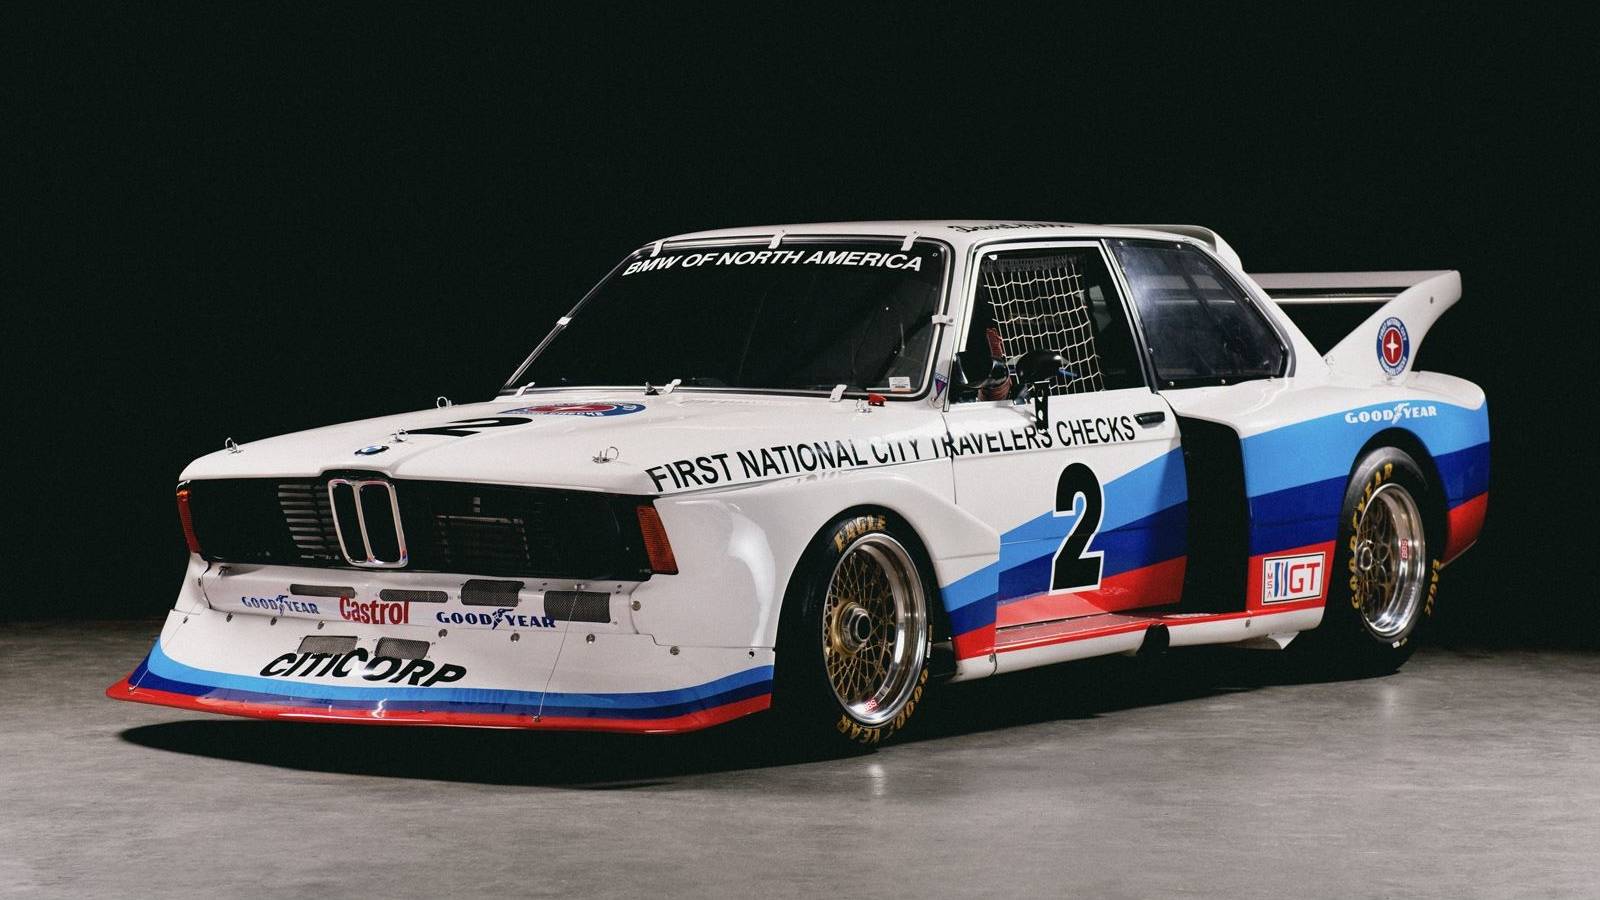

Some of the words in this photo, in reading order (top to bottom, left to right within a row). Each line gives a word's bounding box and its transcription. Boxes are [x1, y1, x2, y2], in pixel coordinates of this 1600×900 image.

[622, 255, 683, 276] BMW
[681, 253, 719, 268] OF
[716, 250, 805, 266] NORTH
[803, 250, 922, 272] AMERICA
[1344, 403, 1438, 425] GOODYEAR
[645, 453, 733, 493] FIRST
[736, 439, 868, 479] NATIONAL
[1056, 415, 1136, 447] CHECKS
[834, 515, 888, 552] EAGLE
[1050, 462, 1104, 593] 2
[1289, 562, 1321, 593] GT
[241, 594, 321, 616] GOODYEAR
[339, 592, 409, 625] Castrol
[436, 608, 557, 630] GOODYEAR
[259, 647, 467, 687] CITICORP
